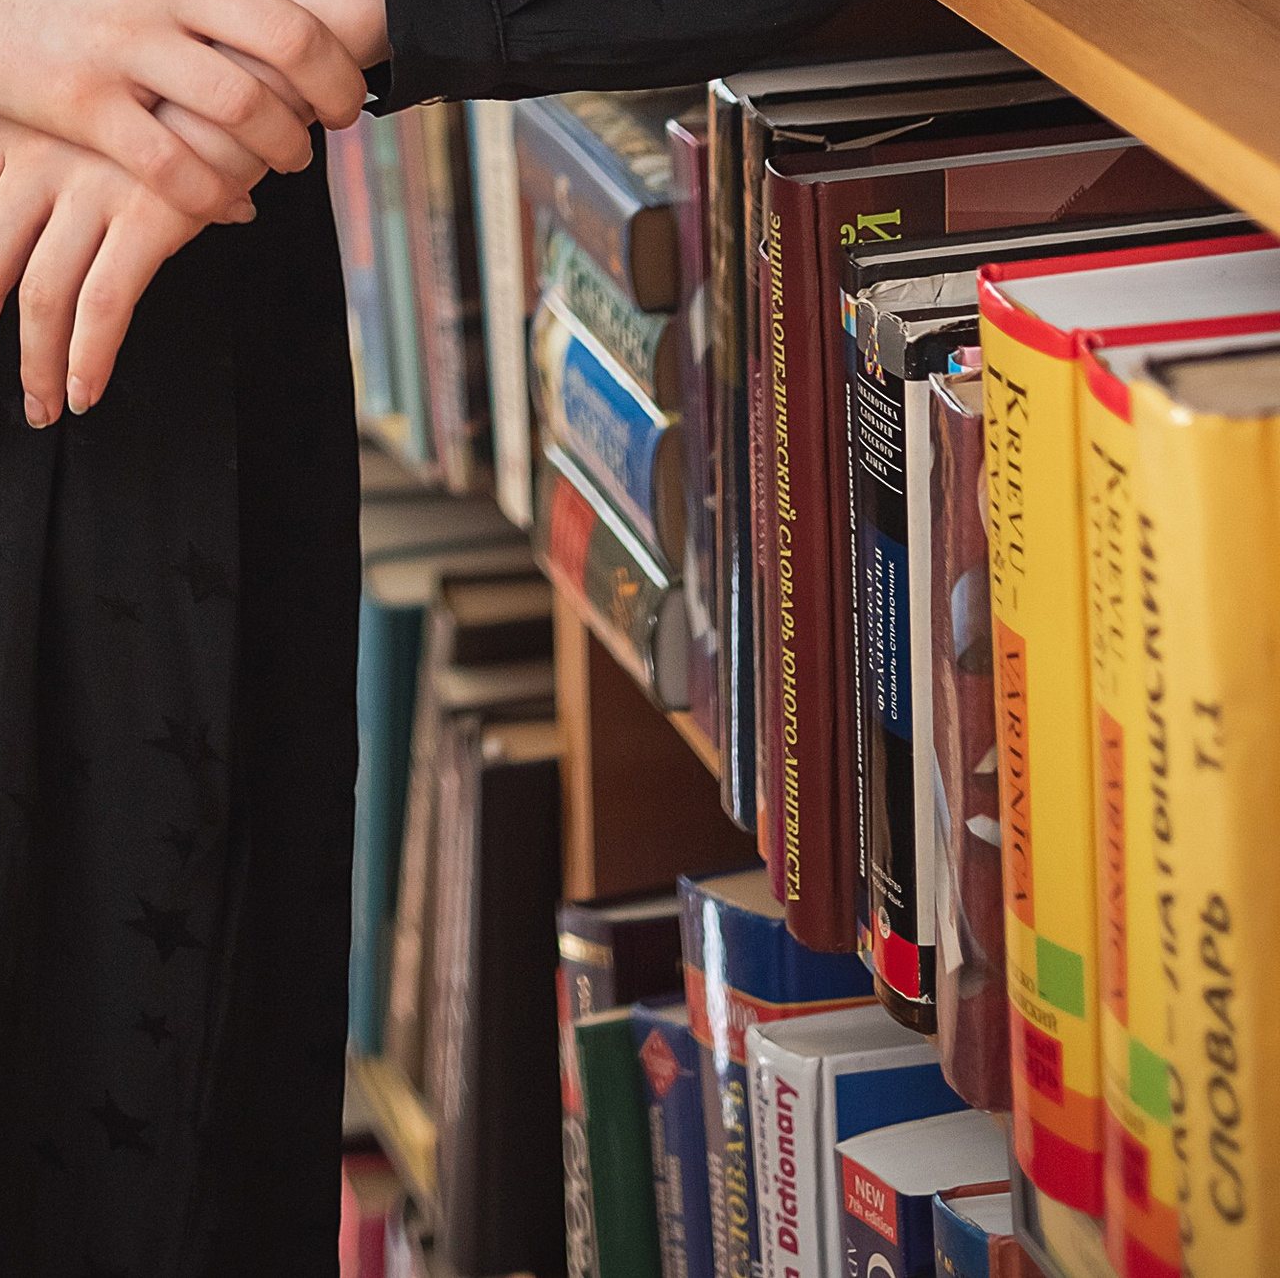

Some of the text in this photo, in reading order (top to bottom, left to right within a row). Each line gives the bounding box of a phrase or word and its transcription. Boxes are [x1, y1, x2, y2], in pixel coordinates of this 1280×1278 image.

[857, 381, 898, 421] БИБЛИОТЕКА
[860, 405, 893, 439] СЛОВАРЕЙ
[860, 426, 893, 459] РУССКОГО
[846, 446, 856, 530] русского
[865, 451, 888, 477] ЯЗЫКА
[768, 211, 801, 902] ЭНЦИКЛОПЕДИЧЕСКИЙ СЛОВАРЬ ЮНОГО ЛИНГВИСТА
[866, 567, 874, 671] РУССКАЯ
[874, 545, 885, 712] ФРАЗЕОЛОГИЯ
[888, 559, 899, 720] СЛОВАРЬ-СПРАВОЧНИК
[852, 612, 862, 774] этимологический
[858, 776, 866, 878] Школьный
[1006, 649, 1033, 903] VĀRDNĪCA
[1198, 891, 1246, 1226] СЛОВАРЬ
[773, 1074, 799, 1255] Dictionary
[854, 1175, 886, 1213] NEW
[847, 1195, 894, 1239] 7th edition
